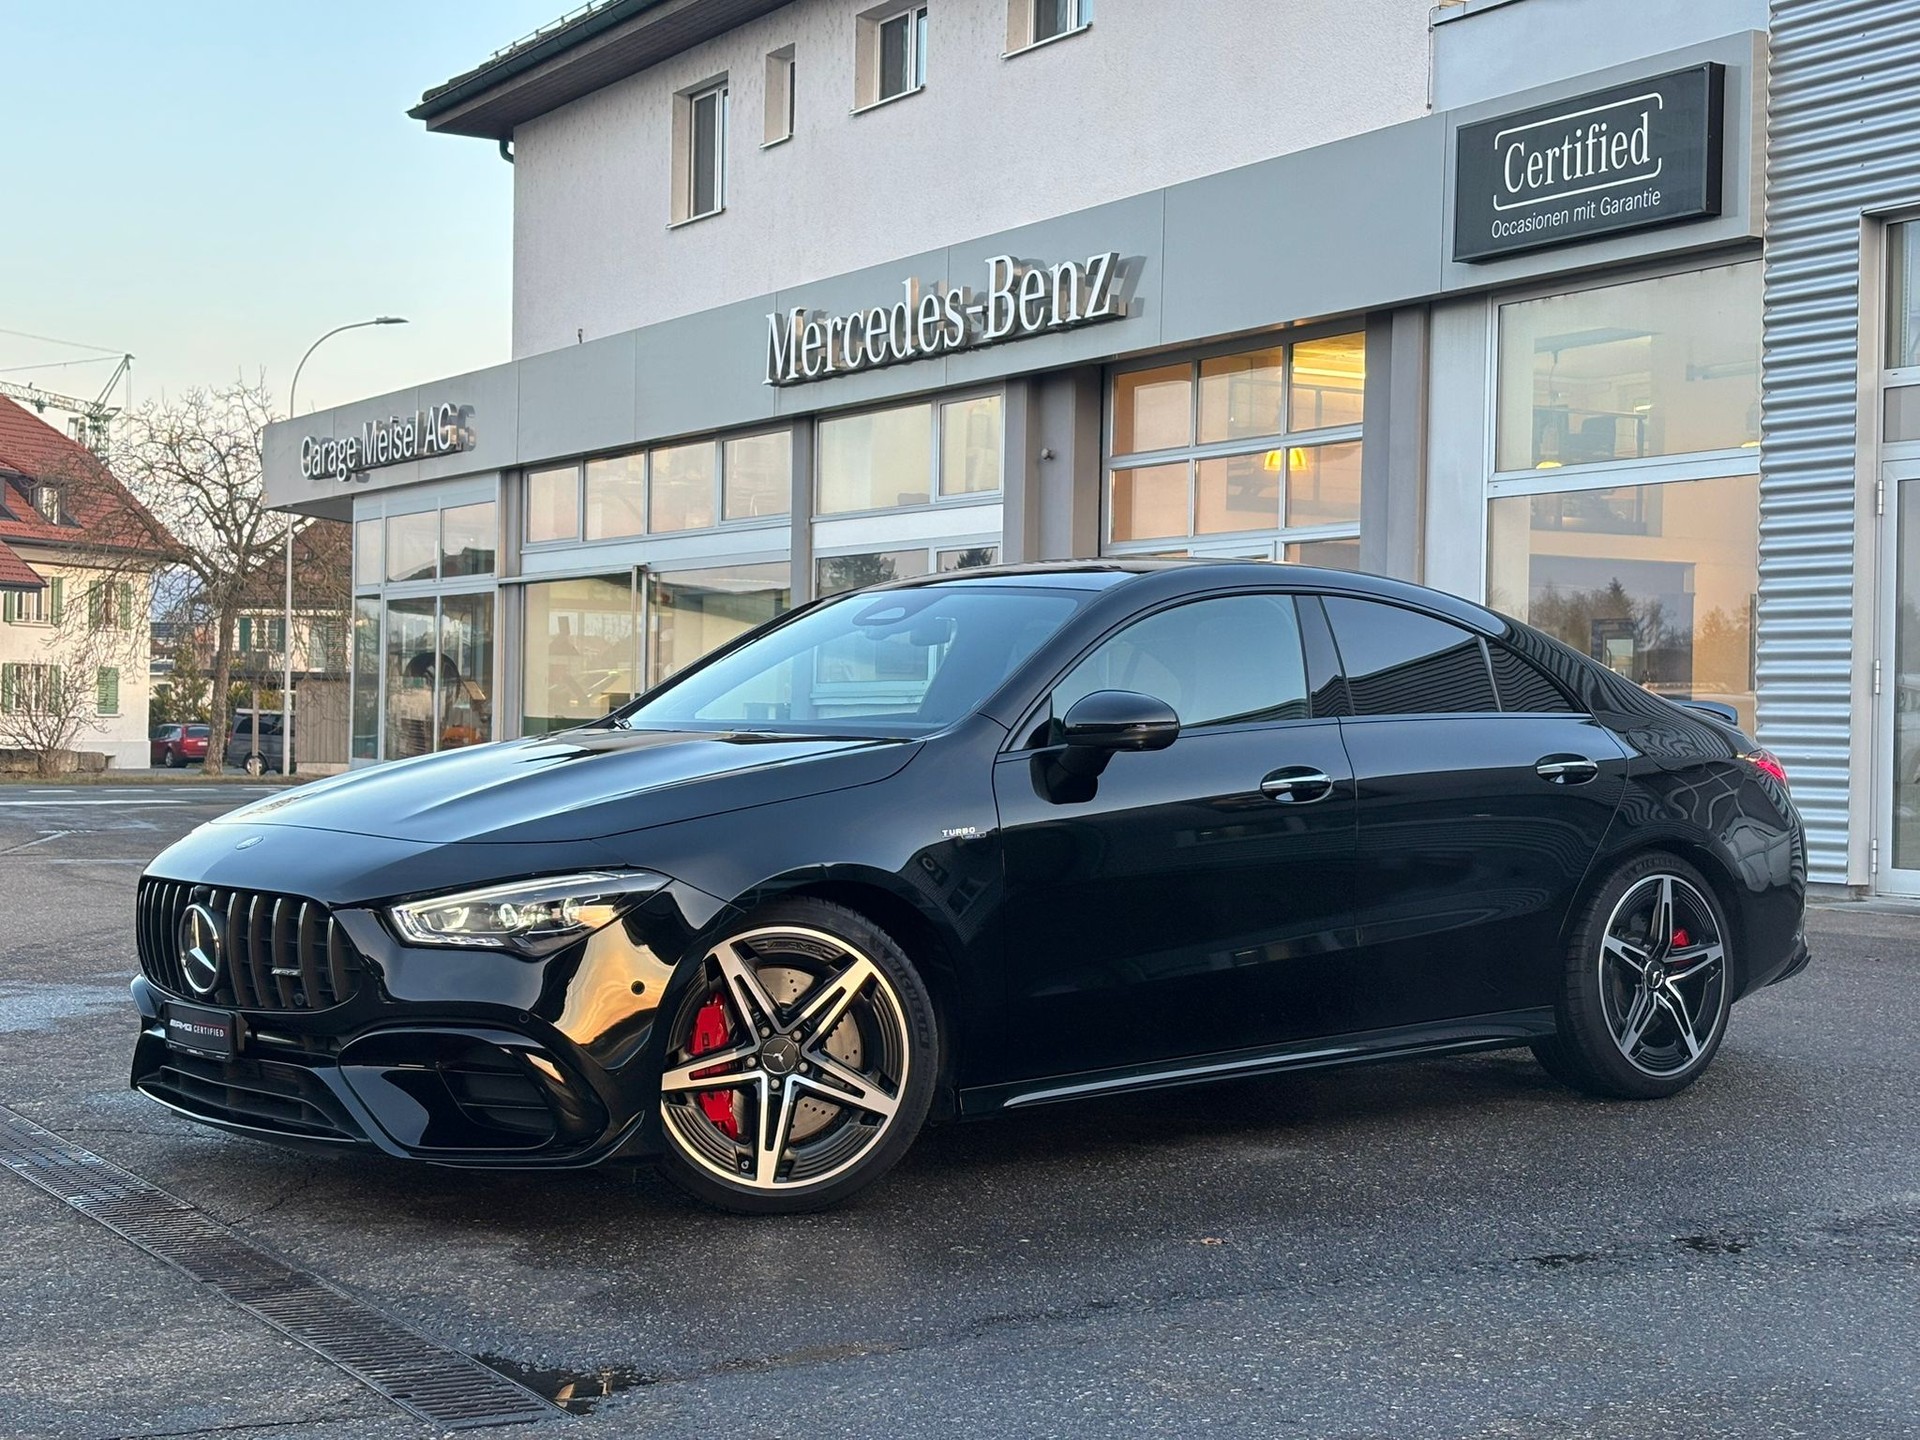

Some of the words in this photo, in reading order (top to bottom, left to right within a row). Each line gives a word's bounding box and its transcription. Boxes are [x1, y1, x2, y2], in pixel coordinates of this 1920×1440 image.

[1504, 111, 1650, 194] Certified
[1491, 210, 1569, 239] Occasionen
[1573, 201, 1596, 222] mit
[1600, 187, 1661, 215] Garantie
[762, 252, 1120, 385] Mercedes-Benz
[301, 435, 356, 482] Garage
[362, 410, 419, 465] Meisel
[424, 402, 453, 453] AG
[942, 826, 976, 837] TURBO
[193, 1025, 224, 1037] CERTIFIED
